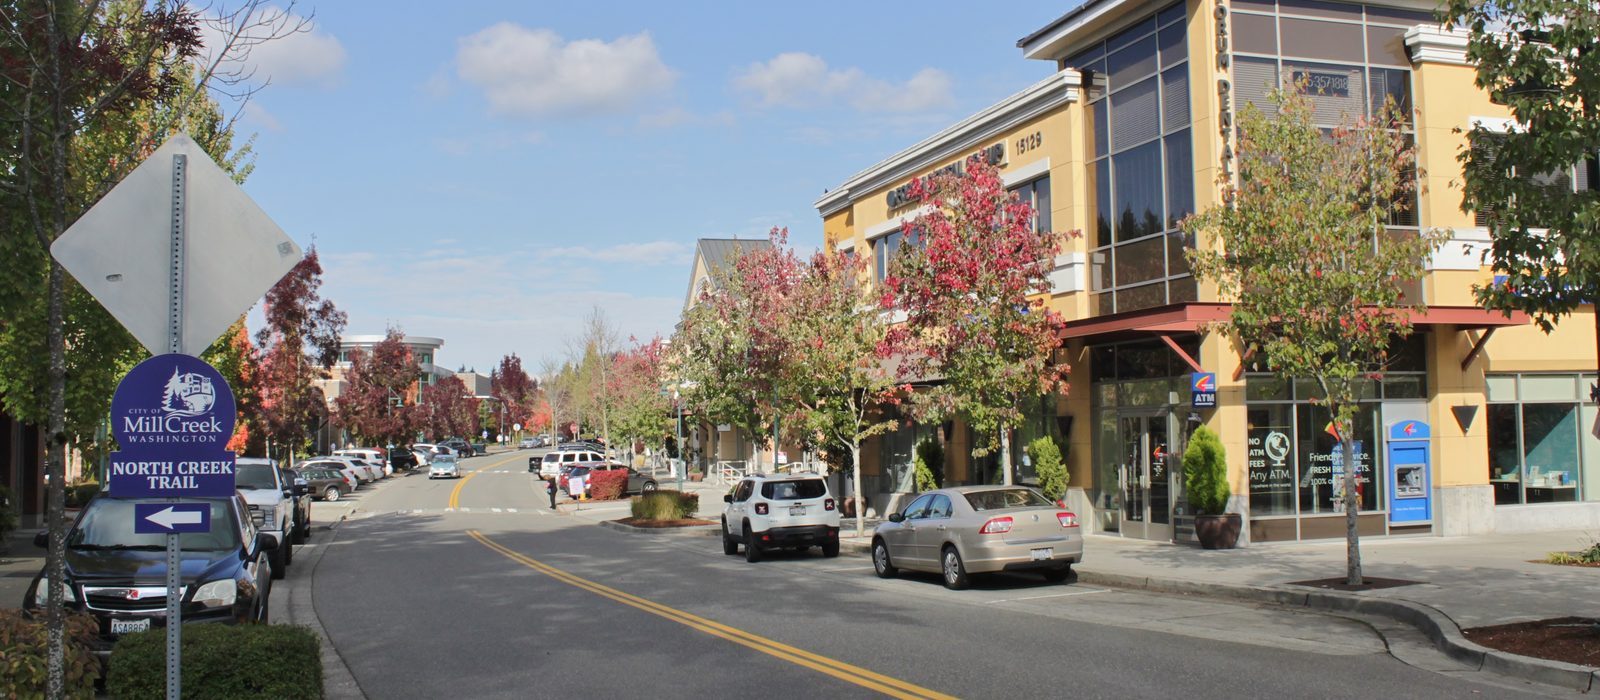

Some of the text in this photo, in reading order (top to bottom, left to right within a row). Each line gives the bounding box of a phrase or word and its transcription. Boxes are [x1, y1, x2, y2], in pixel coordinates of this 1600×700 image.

[1218, 79, 1233, 178] DENTAL
[1016, 131, 1041, 156] 15129
[1195, 393, 1215, 402] ATM
[123, 416, 223, 433] Mill Creek
[128, 435, 217, 443] WASHINGTON
[113, 461, 233, 476] NORTH CREEK
[1249, 460, 1265, 468] FEES
[147, 476, 199, 490] TRAIL
[1250, 470, 1267, 482] Any
